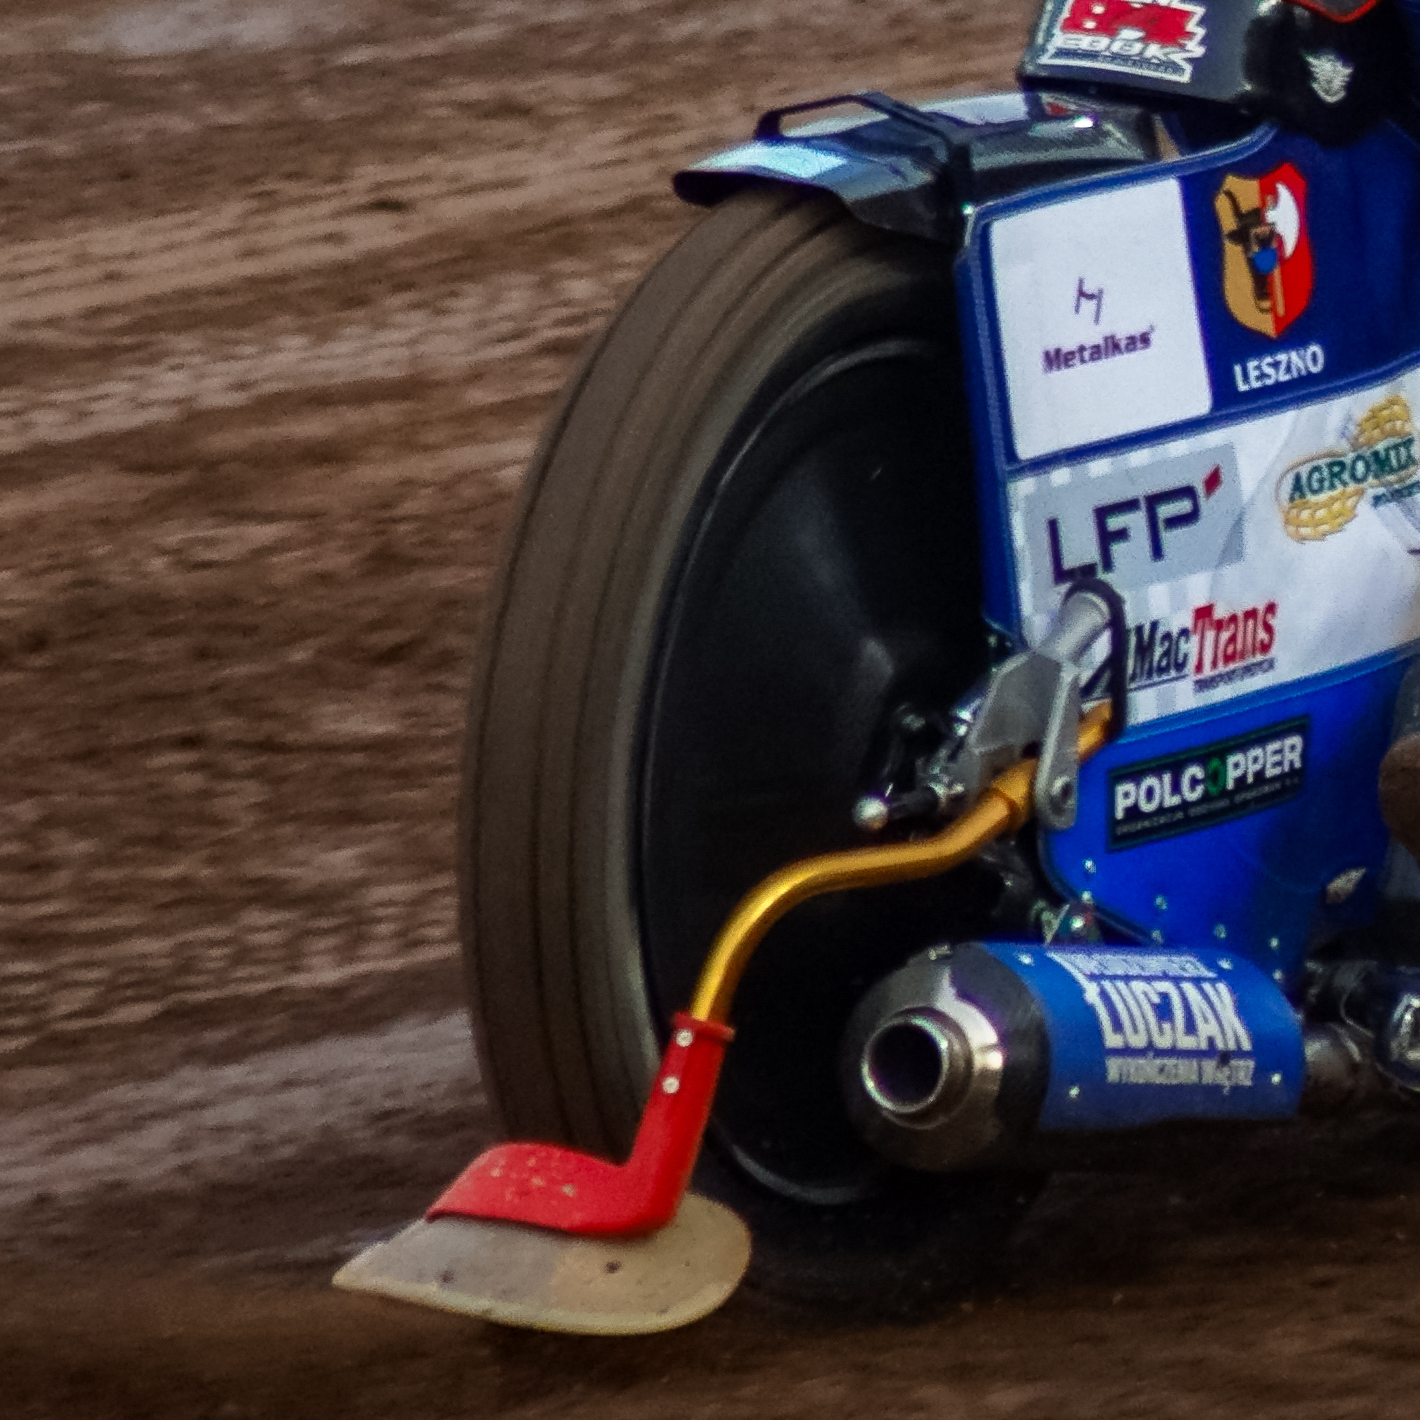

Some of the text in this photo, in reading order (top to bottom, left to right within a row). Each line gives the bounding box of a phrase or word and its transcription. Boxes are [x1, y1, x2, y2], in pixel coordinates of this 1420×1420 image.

[1041, 327, 1153, 374] Metalkas
[1232, 342, 1325, 392] LESZNO
[1288, 432, 1420, 504] AGROMIX
[1046, 483, 1201, 585] LFP
[1114, 733, 1304, 821] POLCOPPER
